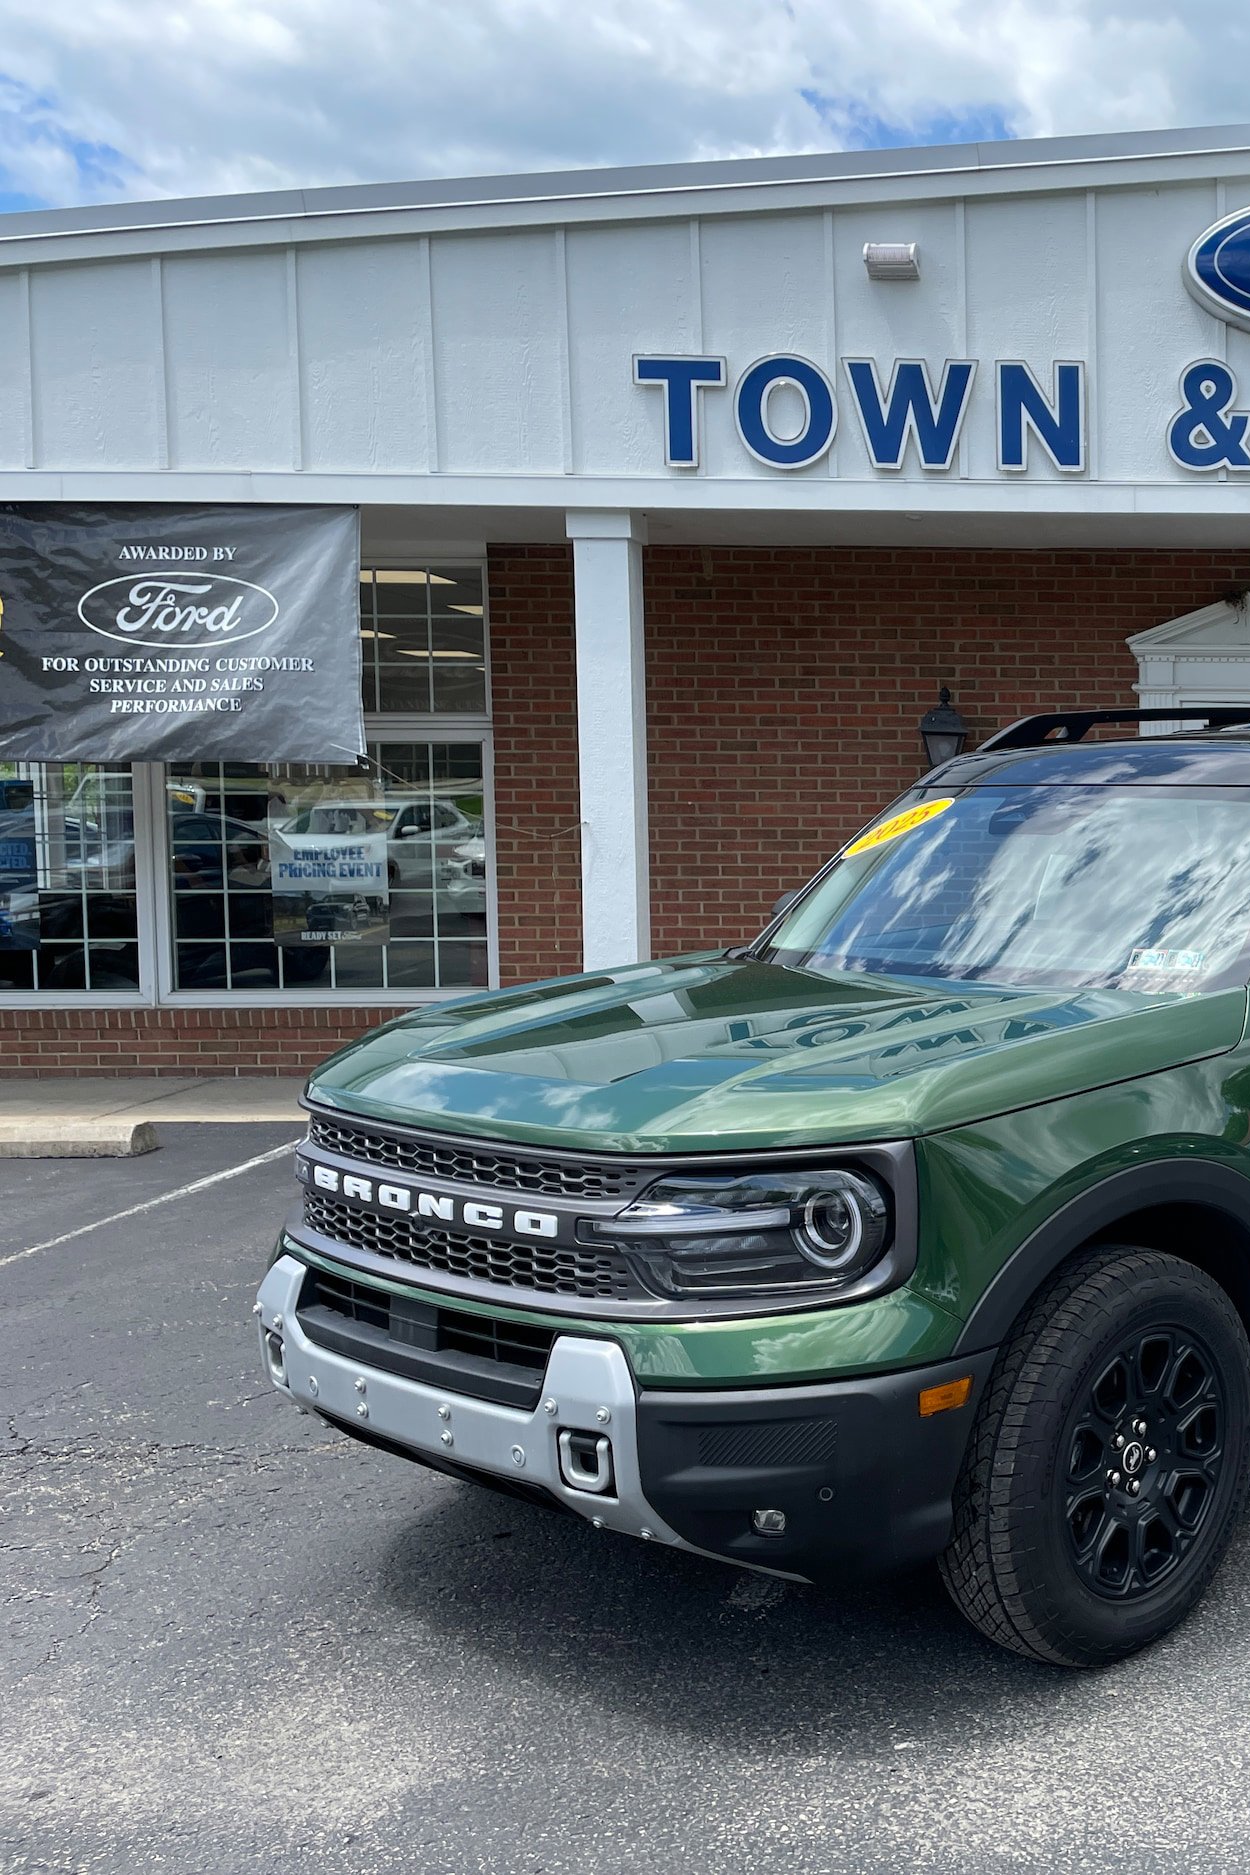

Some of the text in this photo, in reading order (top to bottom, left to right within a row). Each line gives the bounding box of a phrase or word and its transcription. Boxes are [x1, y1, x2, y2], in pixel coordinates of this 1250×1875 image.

[632, 353, 1086, 471] TOWN
[119, 546, 236, 561] AWARDED BY
[116, 581, 244, 632] Ford
[42, 657, 314, 673] FOR OUTSTANDING CUSTOMER
[89, 678, 264, 692] SERVICE AND SALES
[110, 698, 242, 713] PERFORMANCE
[294, 846, 364, 860] EMPLOYEE
[279, 863, 382, 878] PRICING EVENT
[301, 931, 326, 940] READY
[327, 931, 341, 940] SET
[313, 1165, 558, 1238] BRONCO
